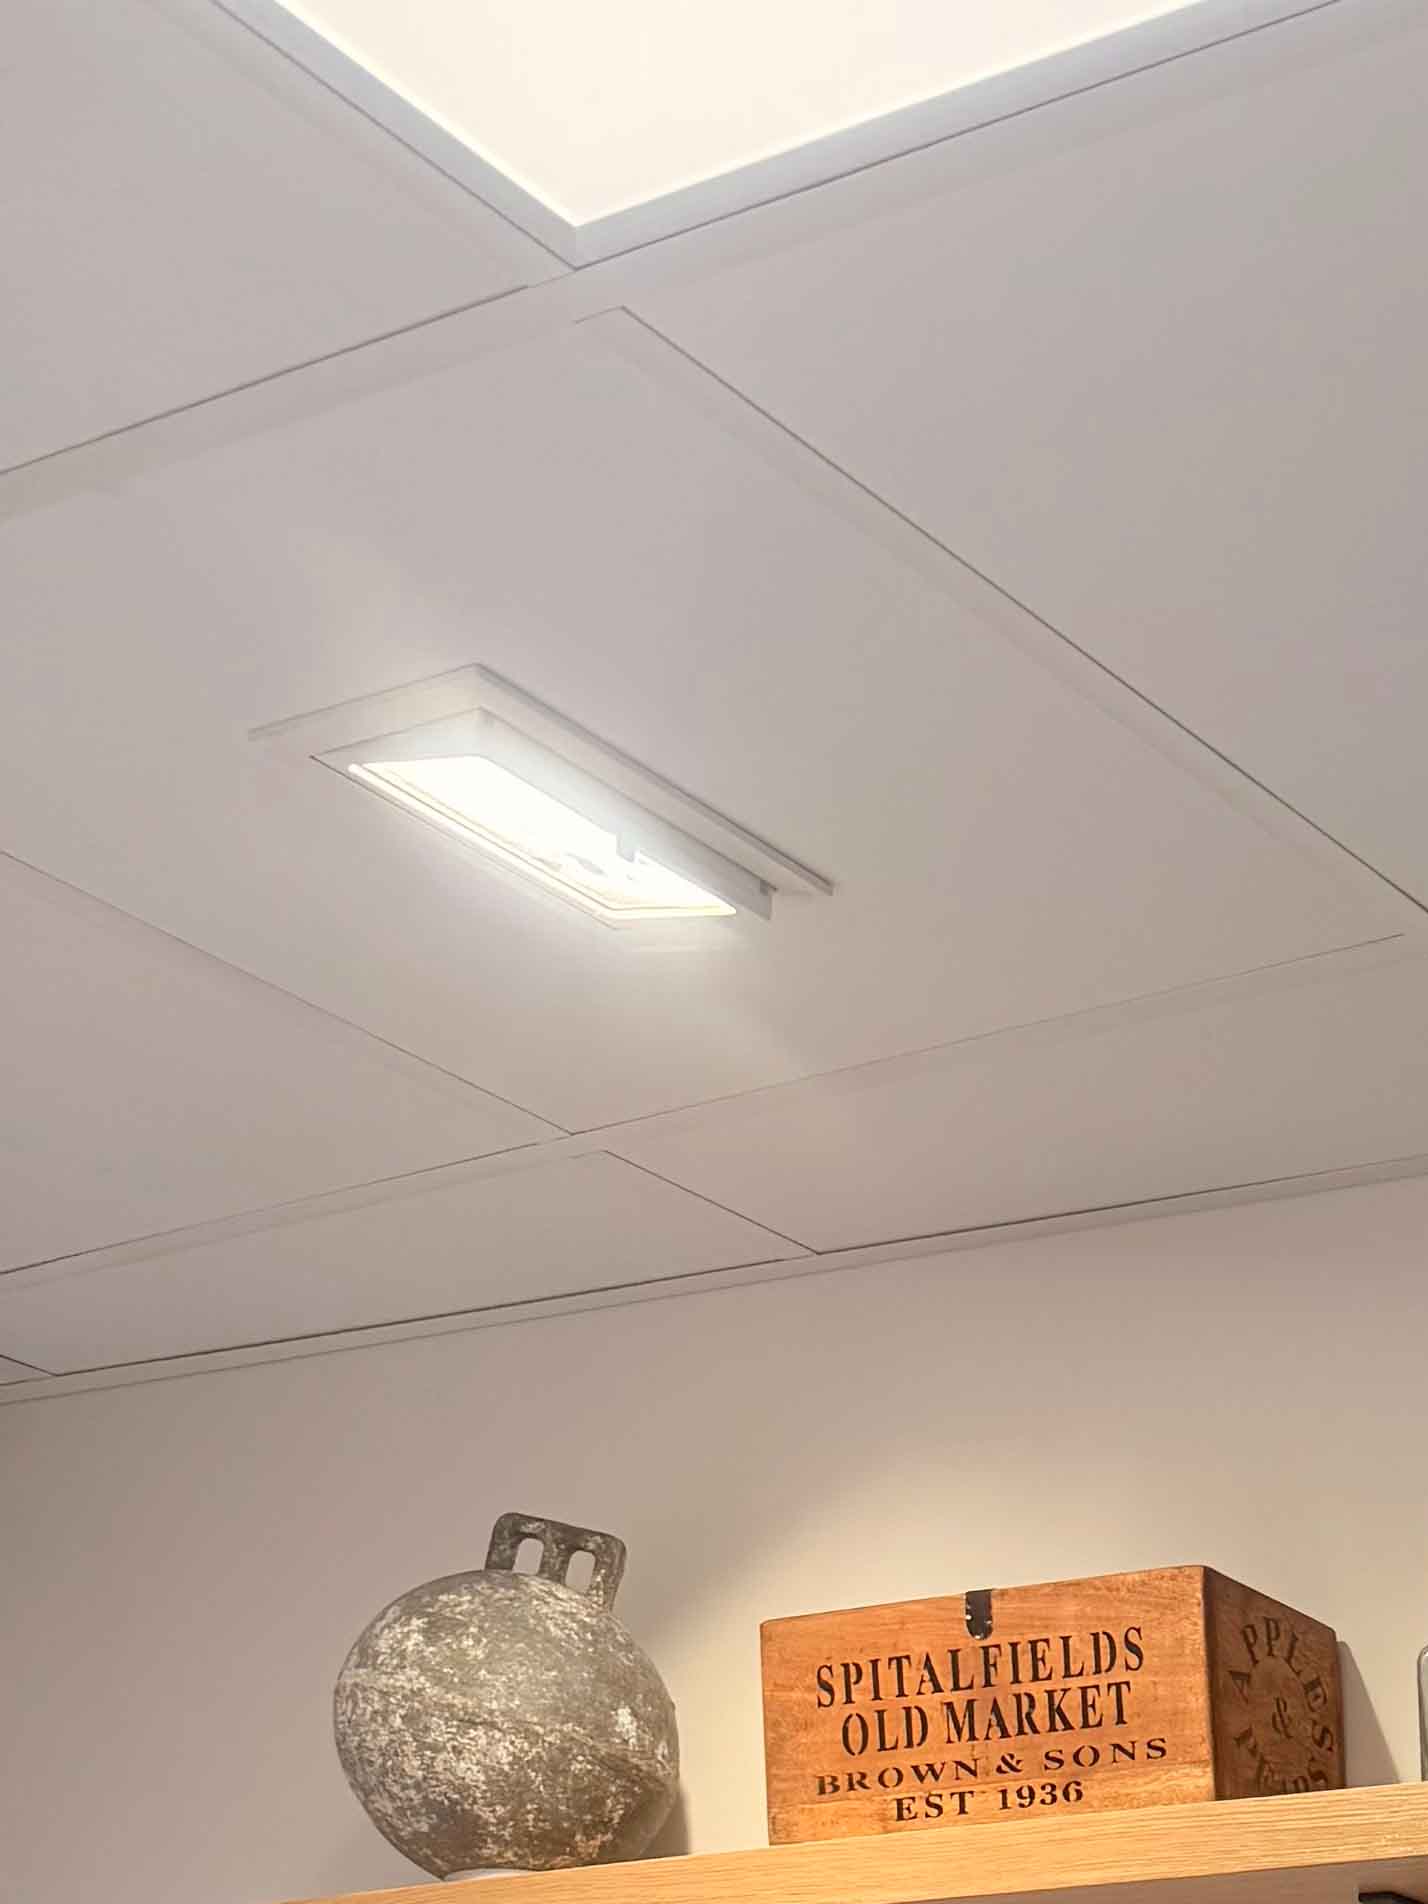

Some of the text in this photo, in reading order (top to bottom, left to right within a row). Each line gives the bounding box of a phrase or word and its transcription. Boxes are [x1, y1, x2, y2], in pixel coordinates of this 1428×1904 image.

[816, 1626, 1145, 1708] SPITALFIELDS
[842, 1681, 1132, 1756] OLD MARKET
[1272, 1697, 1293, 1739] &
[817, 1738, 1168, 1796] BROWN & SONS
[895, 1780, 1083, 1822] EST 1936
